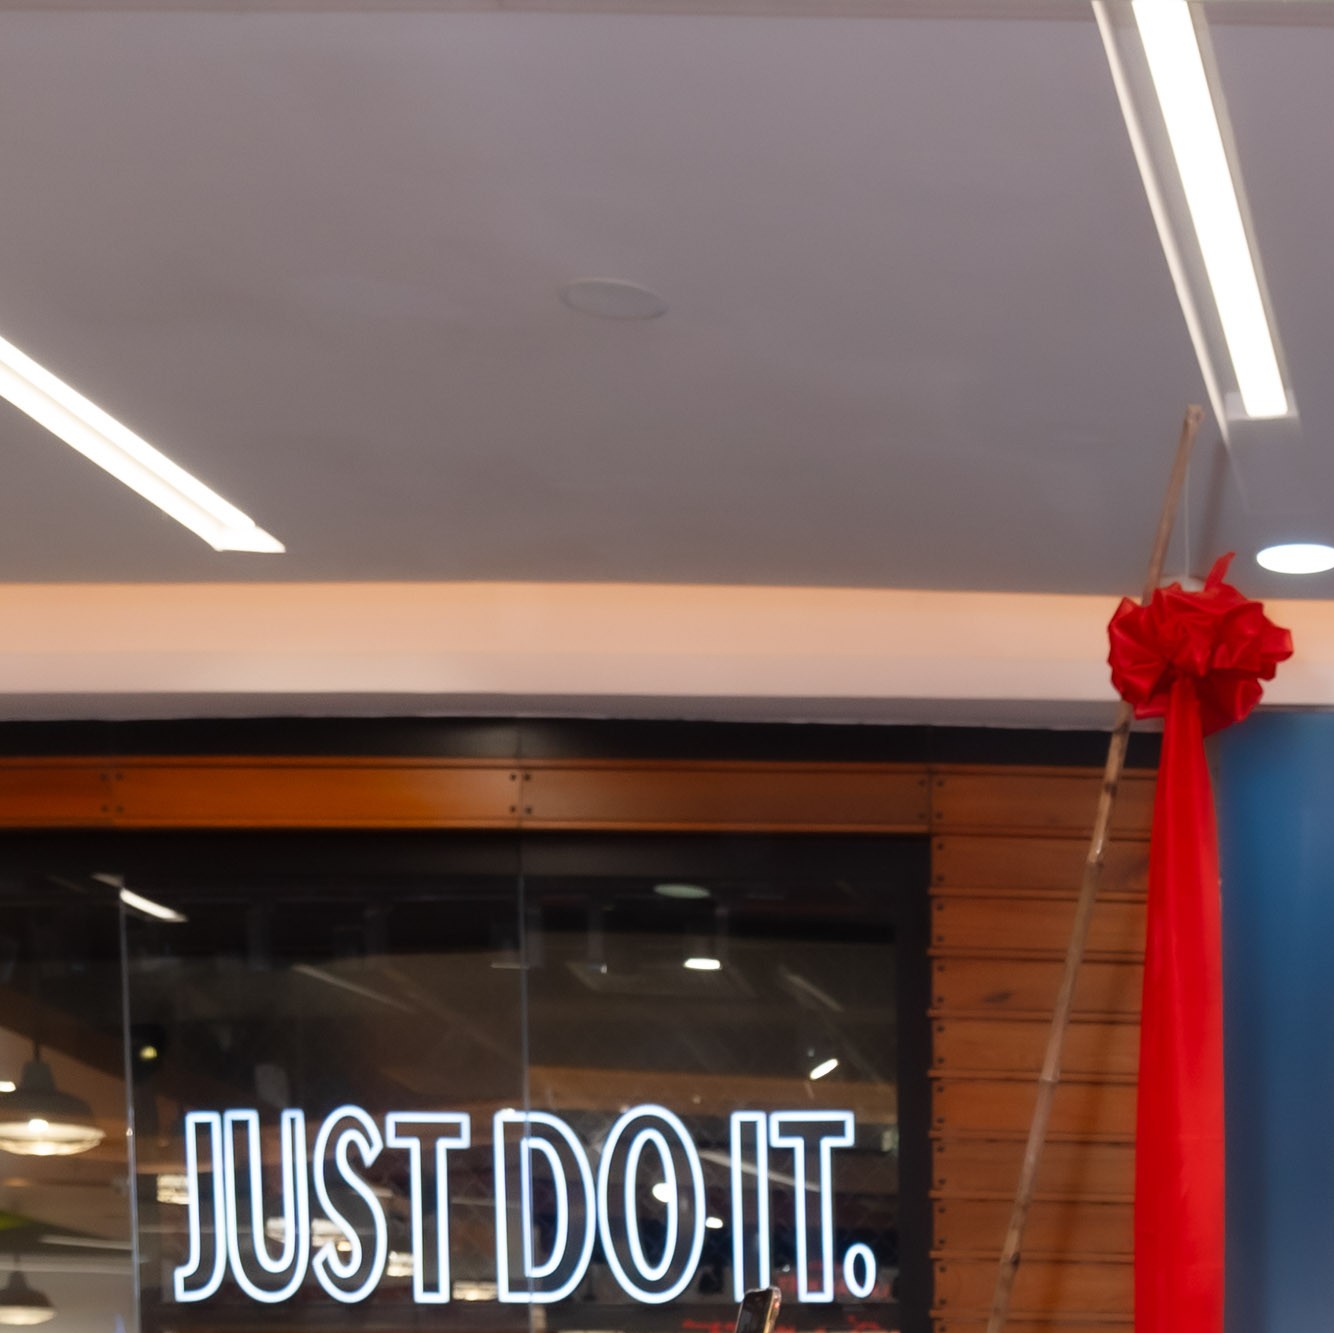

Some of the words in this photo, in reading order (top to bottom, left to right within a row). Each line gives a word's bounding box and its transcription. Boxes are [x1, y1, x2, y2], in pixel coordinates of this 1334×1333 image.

[174, 1104, 480, 1304] JUST
[493, 1104, 706, 1304] DO
[730, 1109, 877, 1303] IT.
